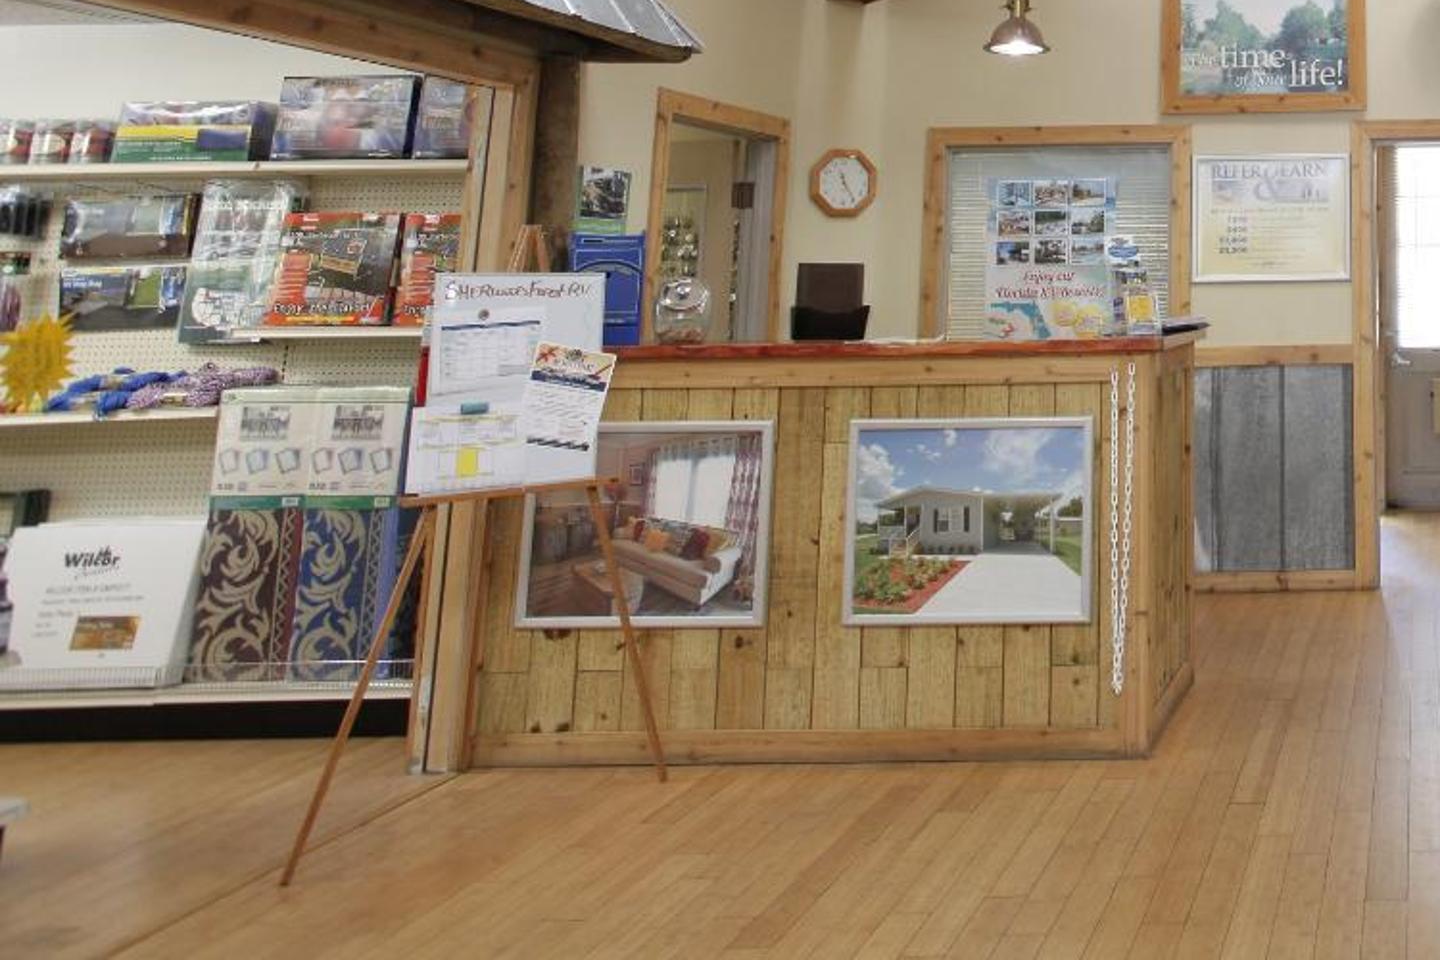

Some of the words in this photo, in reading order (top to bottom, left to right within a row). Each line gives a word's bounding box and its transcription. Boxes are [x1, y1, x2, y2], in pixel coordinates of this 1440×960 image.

[1220, 43, 1287, 69] time
[1288, 58, 1344, 87] life!
[1211, 162, 1261, 179] REFER
[1281, 159, 1328, 178] EARN
